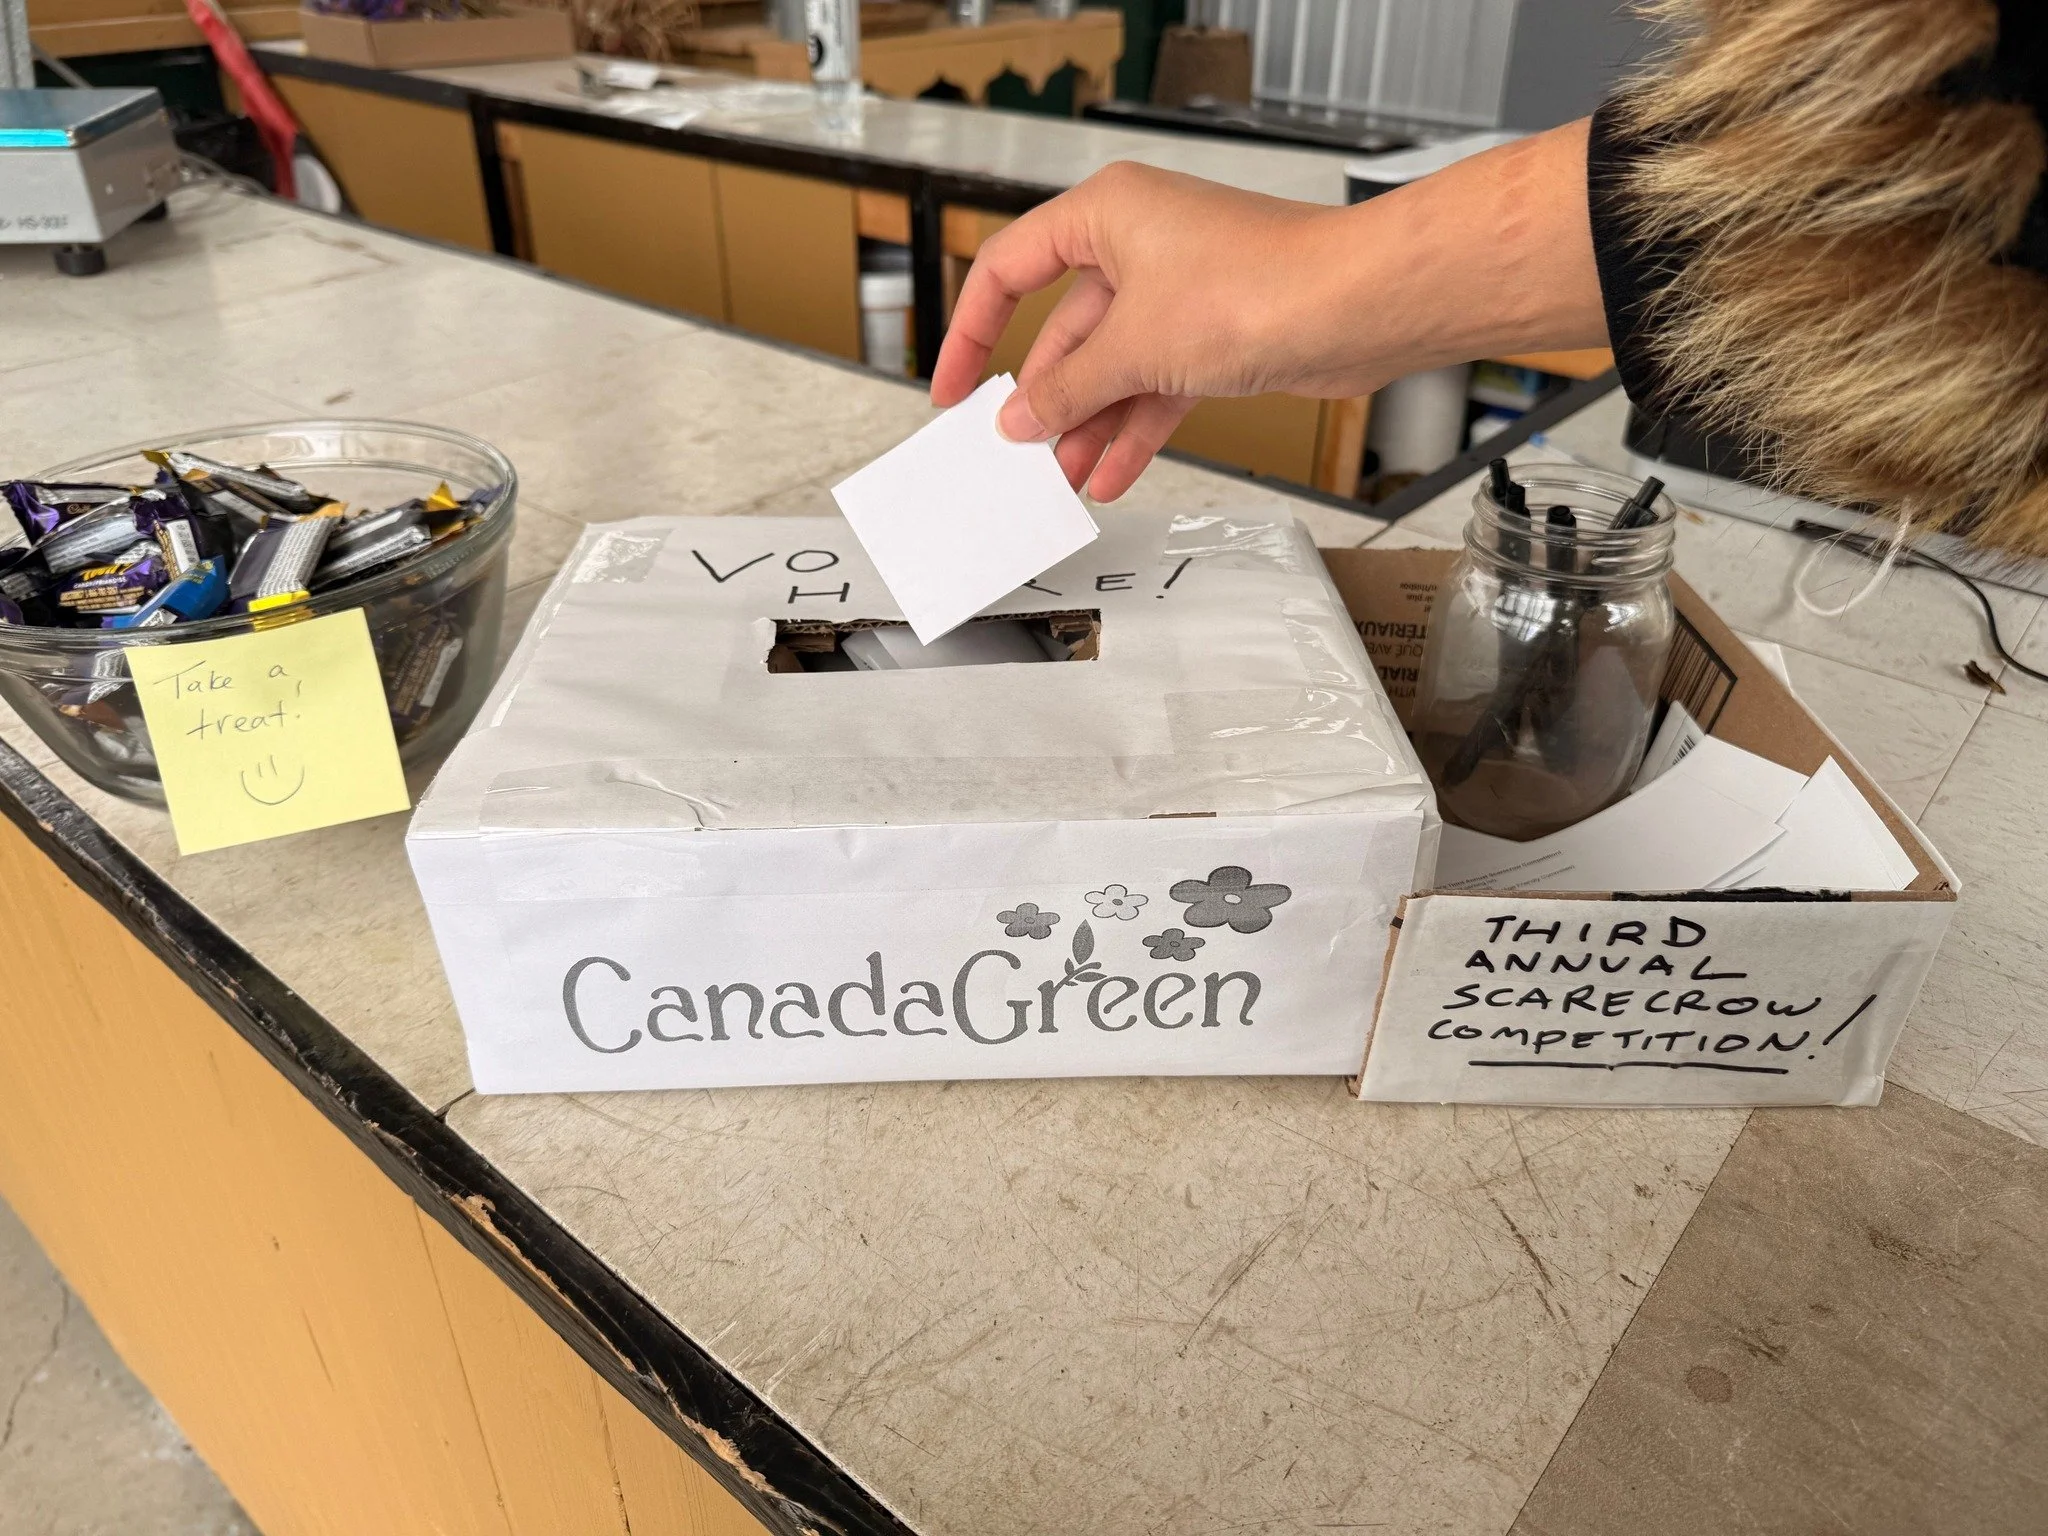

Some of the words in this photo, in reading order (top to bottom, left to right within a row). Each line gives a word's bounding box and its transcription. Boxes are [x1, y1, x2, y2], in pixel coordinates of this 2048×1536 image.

[691, 550, 840, 583] VO
[1354, 621, 1426, 641] TÉRIAUX
[152, 660, 233, 699] Take
[268, 665, 288, 678] a
[1484, 915, 1707, 948] THIRD
[1464, 949, 1748, 981] ANNUAL
[562, 949, 1263, 1054] CanadaGreen
[1442, 983, 1822, 1018] SCARECROW
[1426, 994, 1878, 1061] COMPETITION!
